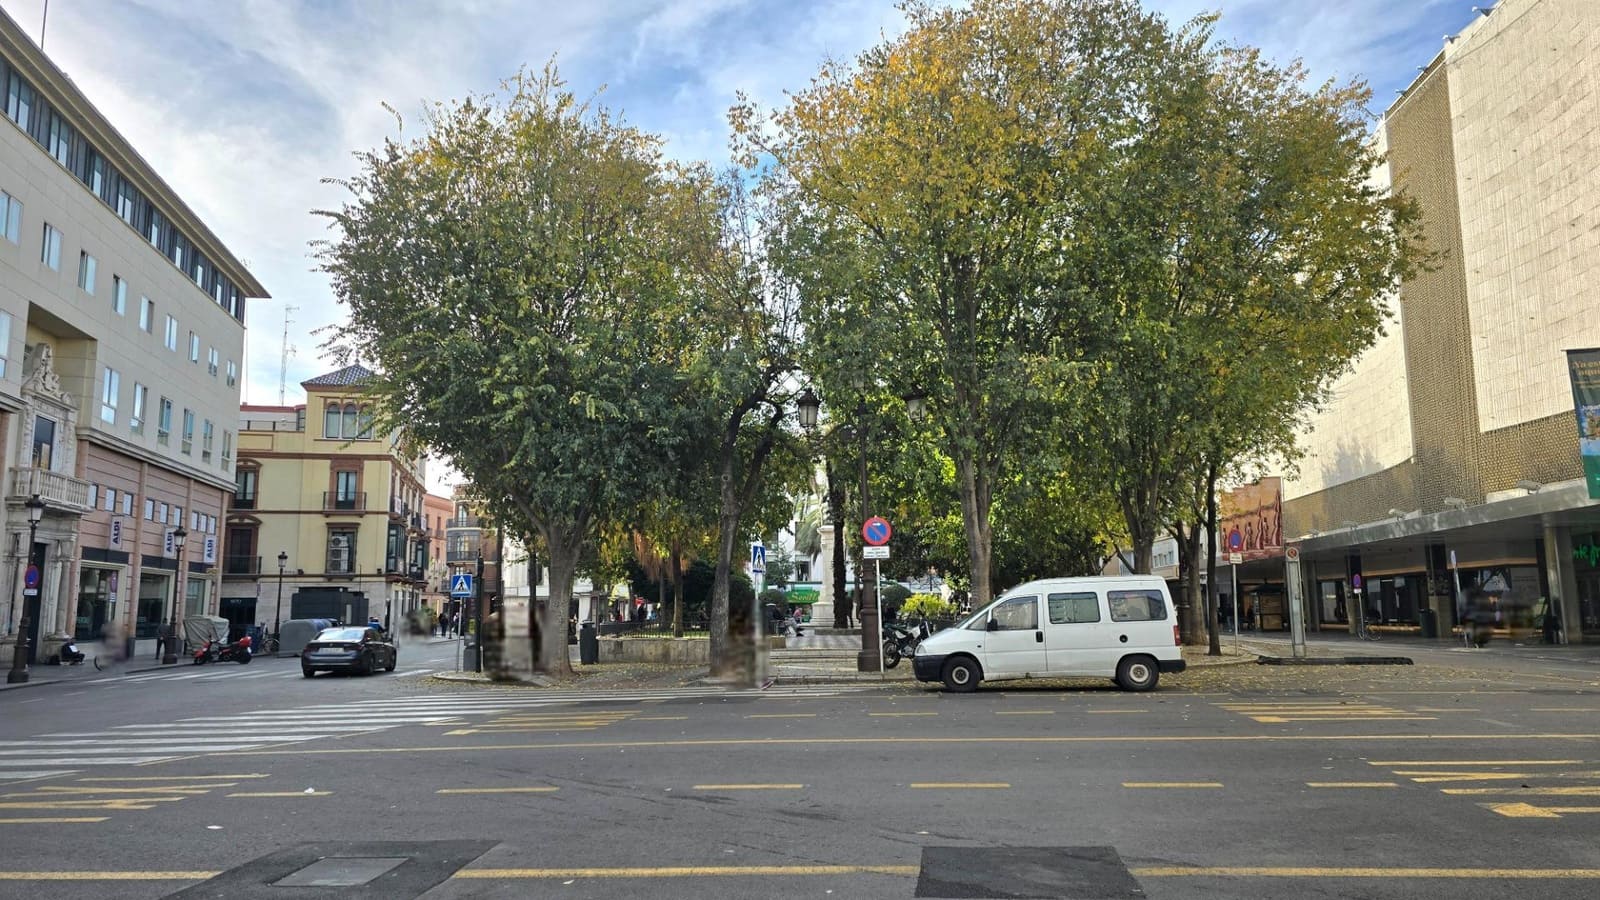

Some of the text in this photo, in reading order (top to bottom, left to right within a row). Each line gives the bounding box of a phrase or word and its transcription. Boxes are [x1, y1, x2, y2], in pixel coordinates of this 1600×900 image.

[112, 521, 121, 544] ALDI
[166, 532, 174, 553] ALDI
[206, 539, 214, 558] ALDI
